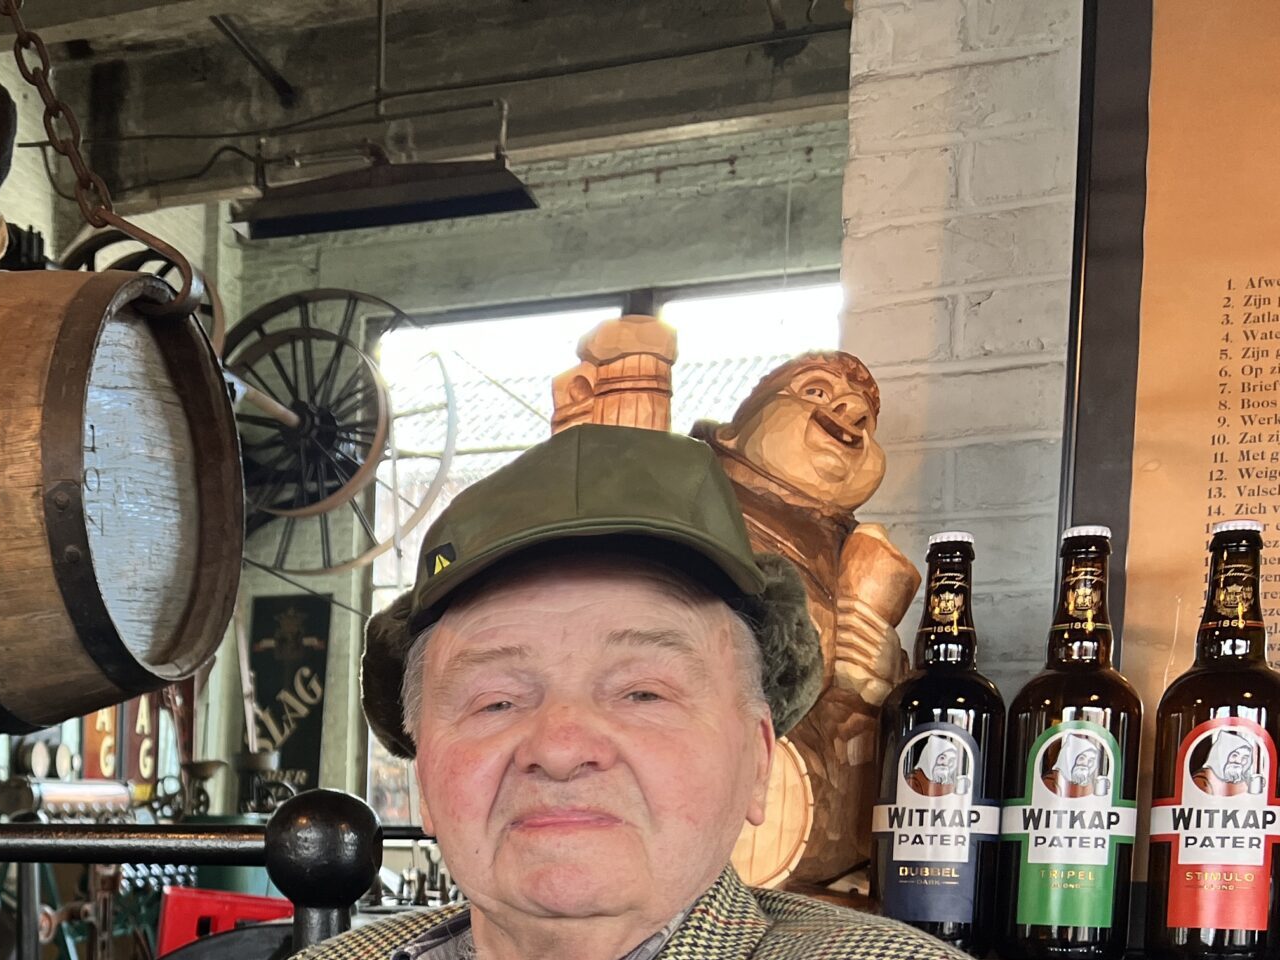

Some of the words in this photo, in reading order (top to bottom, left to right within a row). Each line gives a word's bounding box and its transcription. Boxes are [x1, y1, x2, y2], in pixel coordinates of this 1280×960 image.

[1222, 297, 1234, 308] 2.
[1243, 294, 1271, 309] Zijn
[1221, 313, 1234, 325] 3.
[1219, 349, 1232, 360] 5.
[1241, 346, 1269, 361] Zijn
[1218, 365, 1232, 378] 6.
[1241, 364, 1263, 378] Op
[1219, 383, 1231, 394] 7.
[1218, 400, 1231, 411] 8.
[1241, 398, 1278, 410] Boos
[1217, 416, 1230, 428] 9.
[1211, 433, 1230, 446] 10.
[1239, 431, 1262, 445] Zat
[1238, 450, 1266, 462] Met
[1209, 469, 1227, 481] 12.
[1207, 487, 1226, 499] 13.
[1207, 505, 1225, 517] 14.
[1234, 502, 1267, 515] Zich
[888, 807, 981, 829] WITKAP
[1022, 808, 1120, 831] WITKAP
[1172, 807, 1277, 831] WITKAP
[898, 834, 967, 847] PATER
[1034, 835, 1106, 849] PATER
[1184, 836, 1262, 849] PATER
[899, 866, 960, 878] DUBBEL
[1040, 869, 1096, 881] TRIPEL
[1185, 871, 1255, 882] STIMULO
